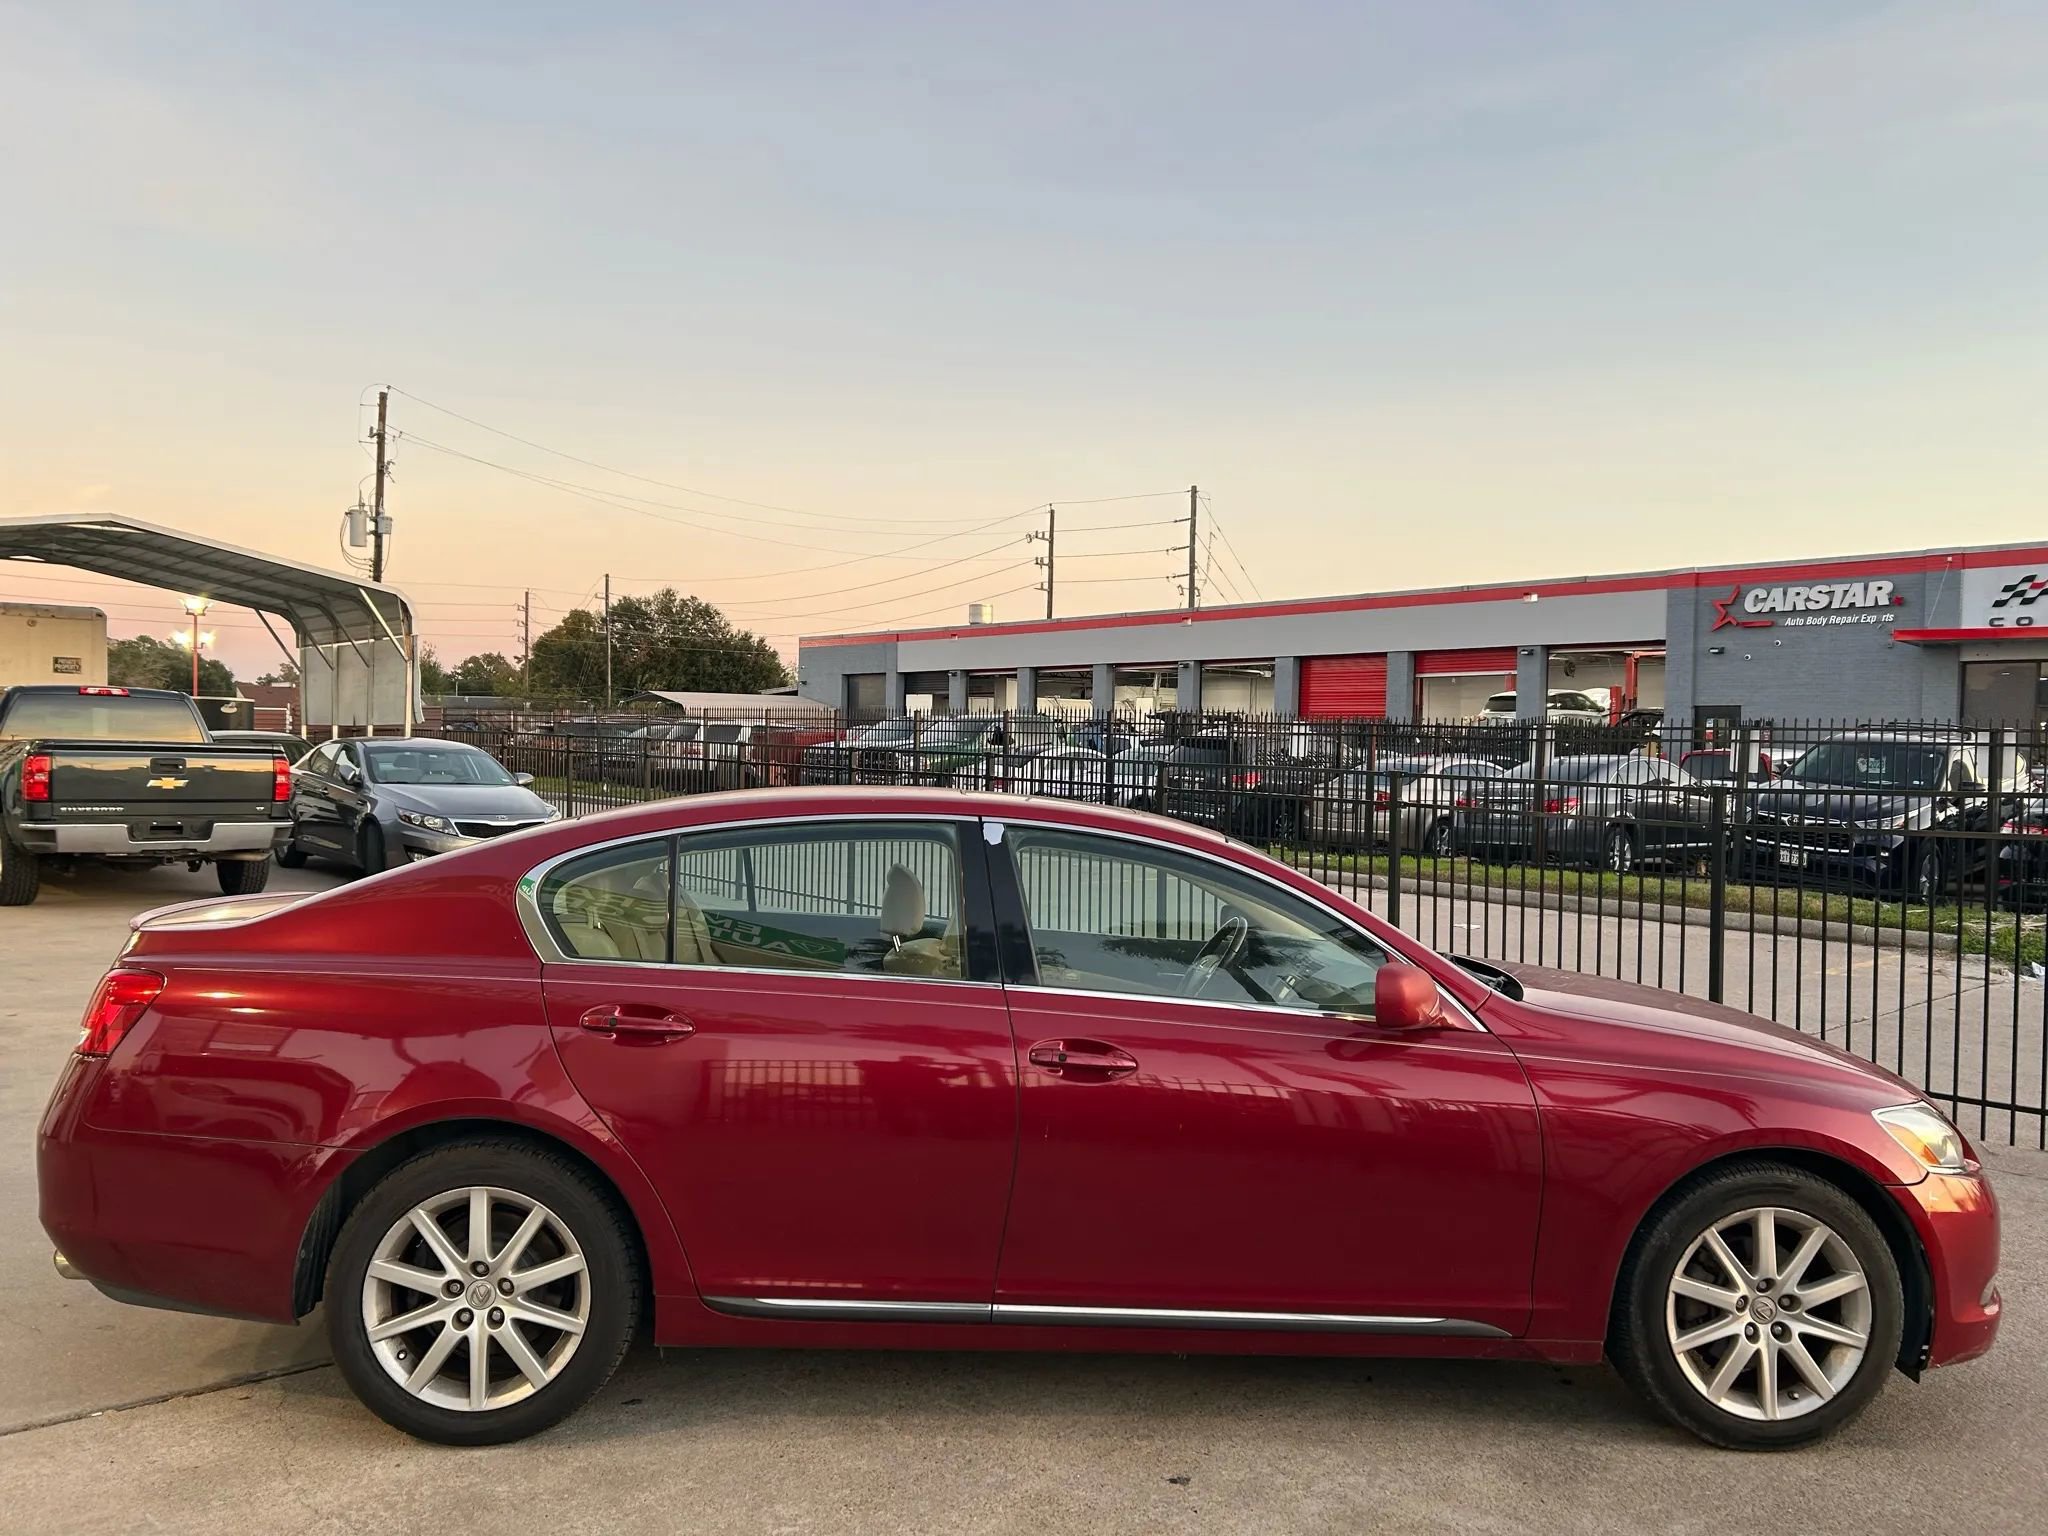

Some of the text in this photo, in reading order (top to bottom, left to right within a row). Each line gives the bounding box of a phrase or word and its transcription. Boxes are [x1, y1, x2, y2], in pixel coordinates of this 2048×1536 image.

[1743, 580, 1894, 613] CARSTAR
[1785, 617, 1804, 626] Auto
[1806, 615, 1828, 627] Body
[1829, 614, 1860, 626] Repair
